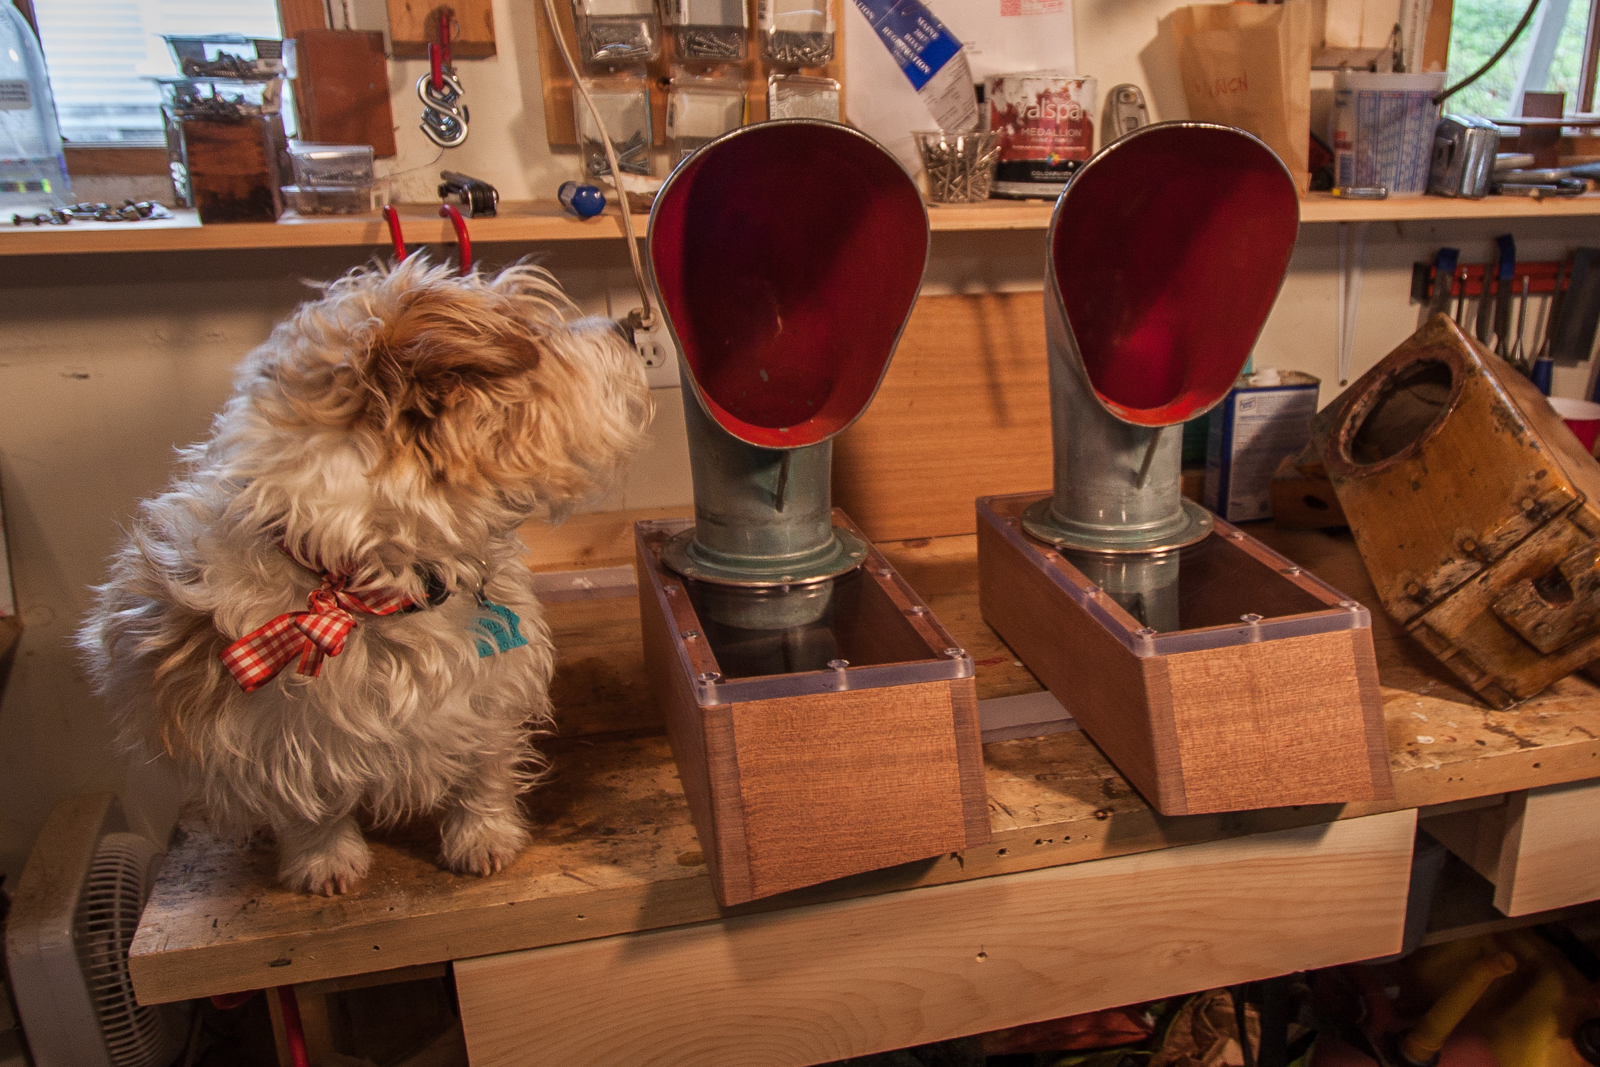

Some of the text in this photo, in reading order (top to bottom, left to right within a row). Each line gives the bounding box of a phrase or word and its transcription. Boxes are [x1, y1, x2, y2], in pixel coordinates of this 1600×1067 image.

[913, 28, 930, 42] 2017
[917, 16, 939, 40] MAINE
[881, 26, 931, 75] REGISTRATION
[903, 32, 924, 53] BOAT
[1020, 127, 1082, 137] MEDALLION
